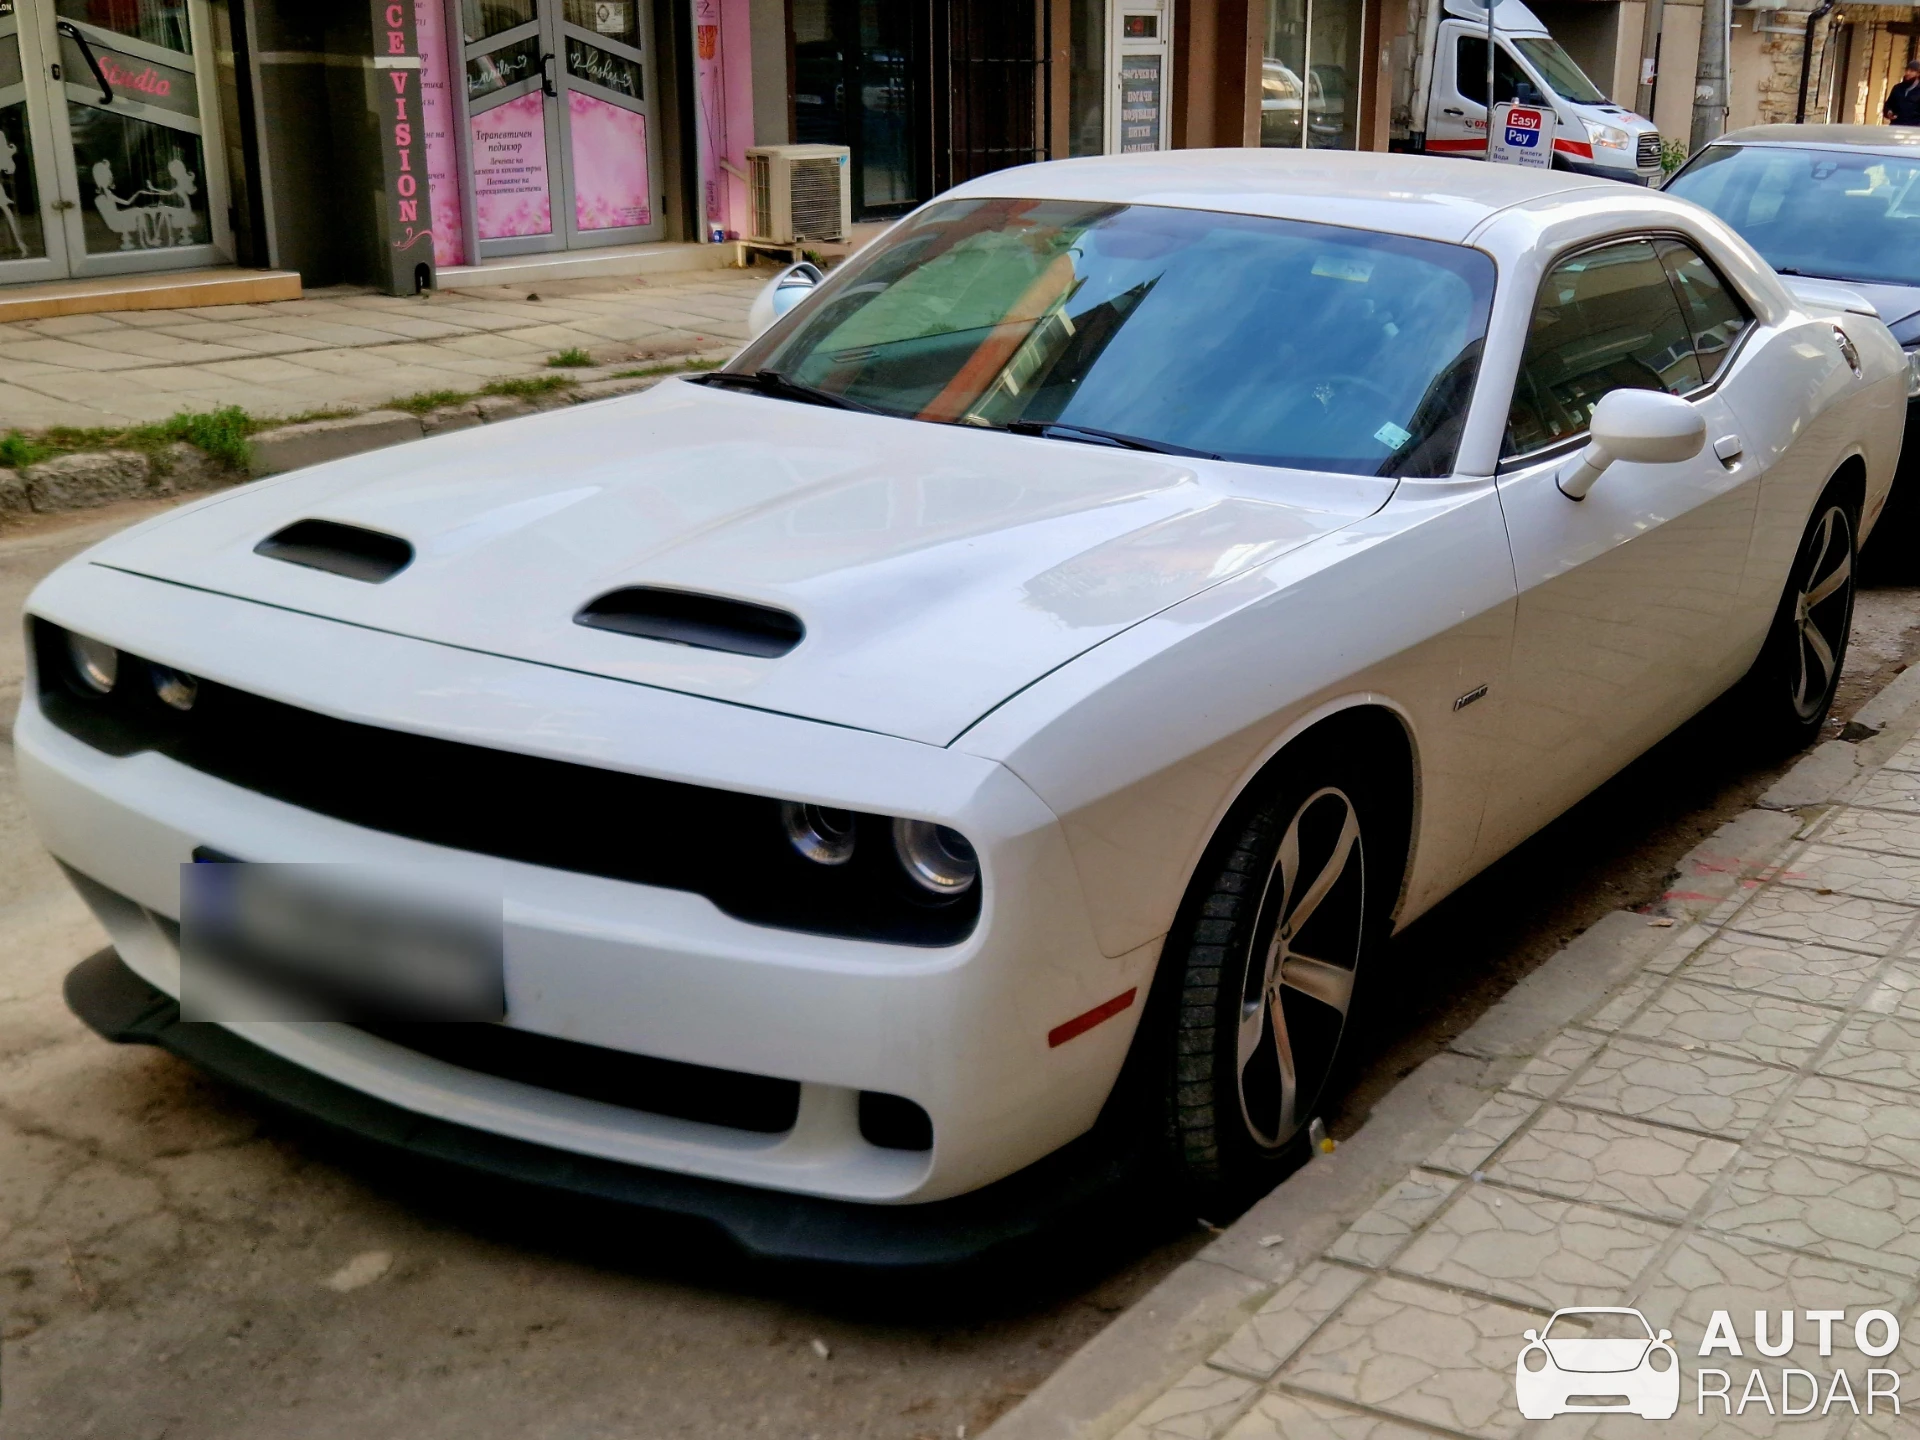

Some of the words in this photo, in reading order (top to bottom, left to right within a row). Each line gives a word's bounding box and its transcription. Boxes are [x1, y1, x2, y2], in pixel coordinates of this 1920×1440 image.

[0, 3, 12, 11] ON
[385, 0, 405, 54] CE
[585, 51, 621, 84] lashes
[95, 56, 171, 96] Studio
[1511, 113, 1538, 128] Easy
[476, 130, 533, 142] Терапевтичен
[1508, 130, 1530, 145] Pay
[390, 72, 418, 222] VISION
[488, 142, 523, 153] педикюр
